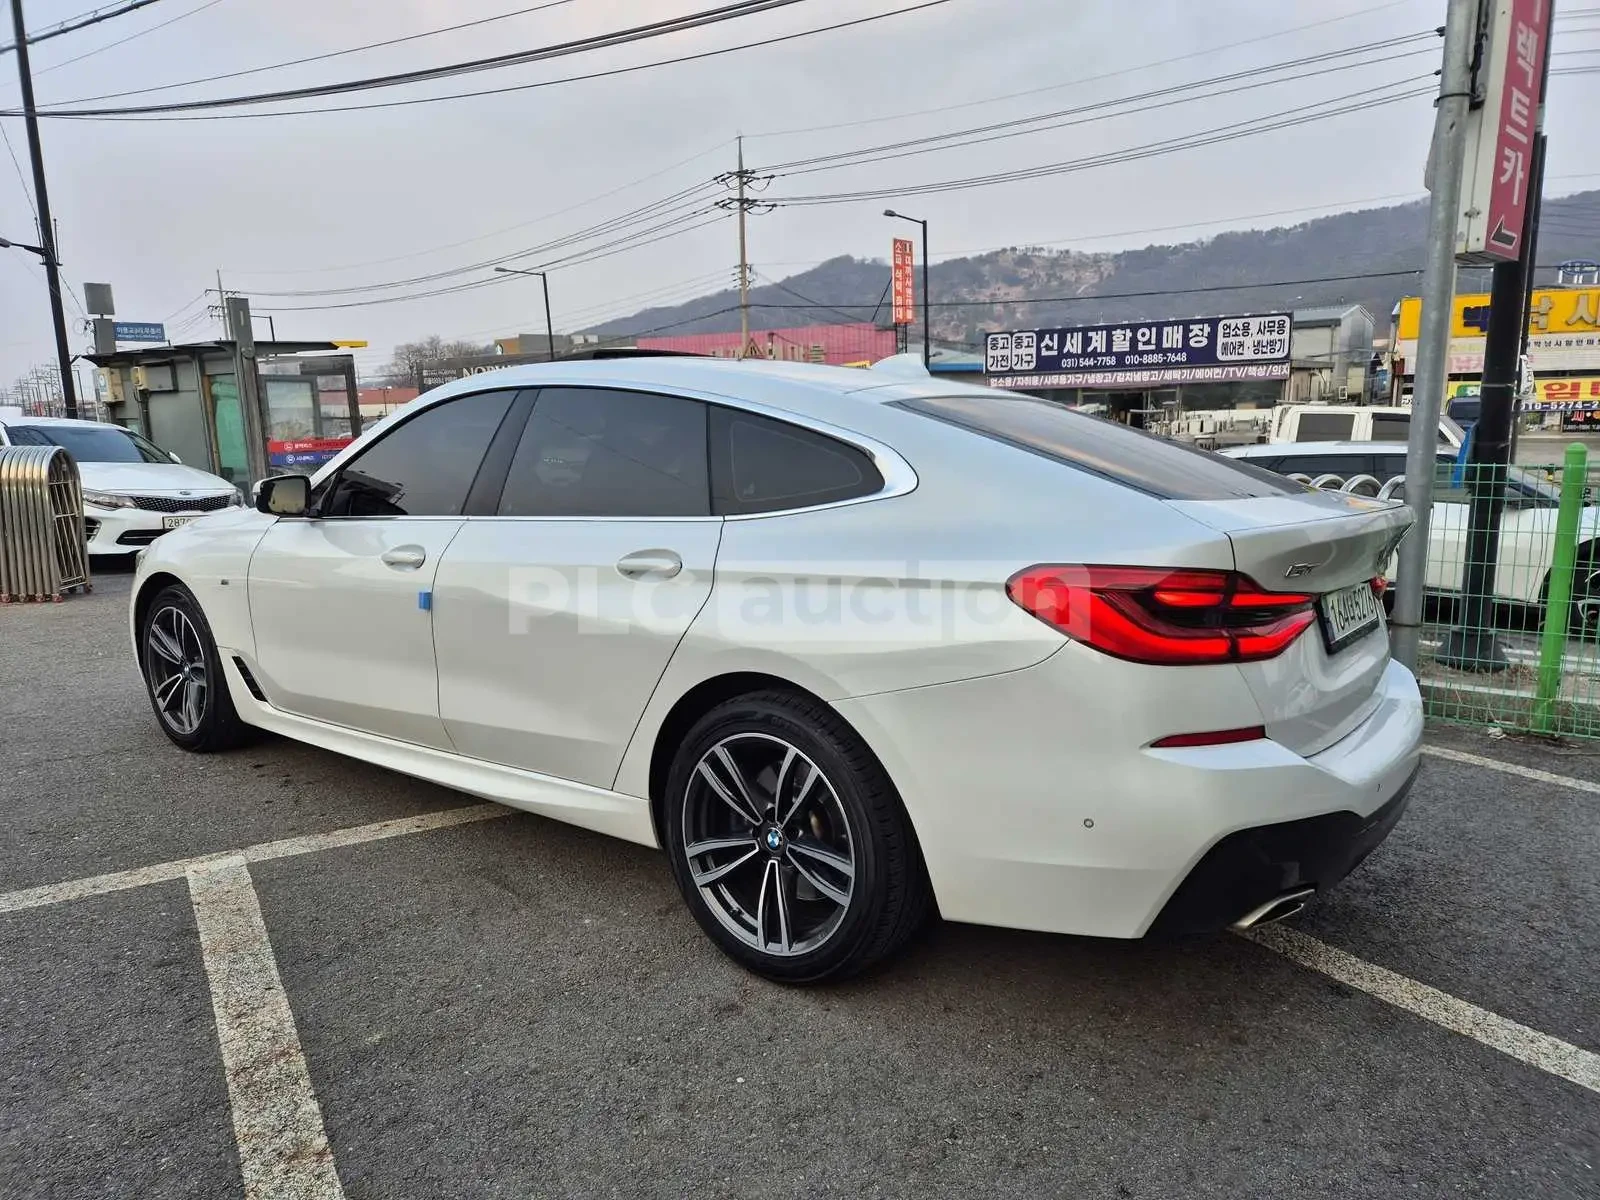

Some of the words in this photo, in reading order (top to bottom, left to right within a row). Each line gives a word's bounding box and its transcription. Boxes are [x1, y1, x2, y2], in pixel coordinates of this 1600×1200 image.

[1500, 0, 1541, 206] 팩트카
[1256, 319, 1286, 336] 사무용
[989, 337, 1009, 351] 중고
[1013, 336, 1034, 349] 중고
[1040, 323, 1211, 357] 신세계할인매장
[989, 354, 1009, 368] 가전
[1013, 353, 1034, 367] 가구
[1125, 352, 1187, 365] 010-8885-7648
[1543, 381, 1600, 401] 임
